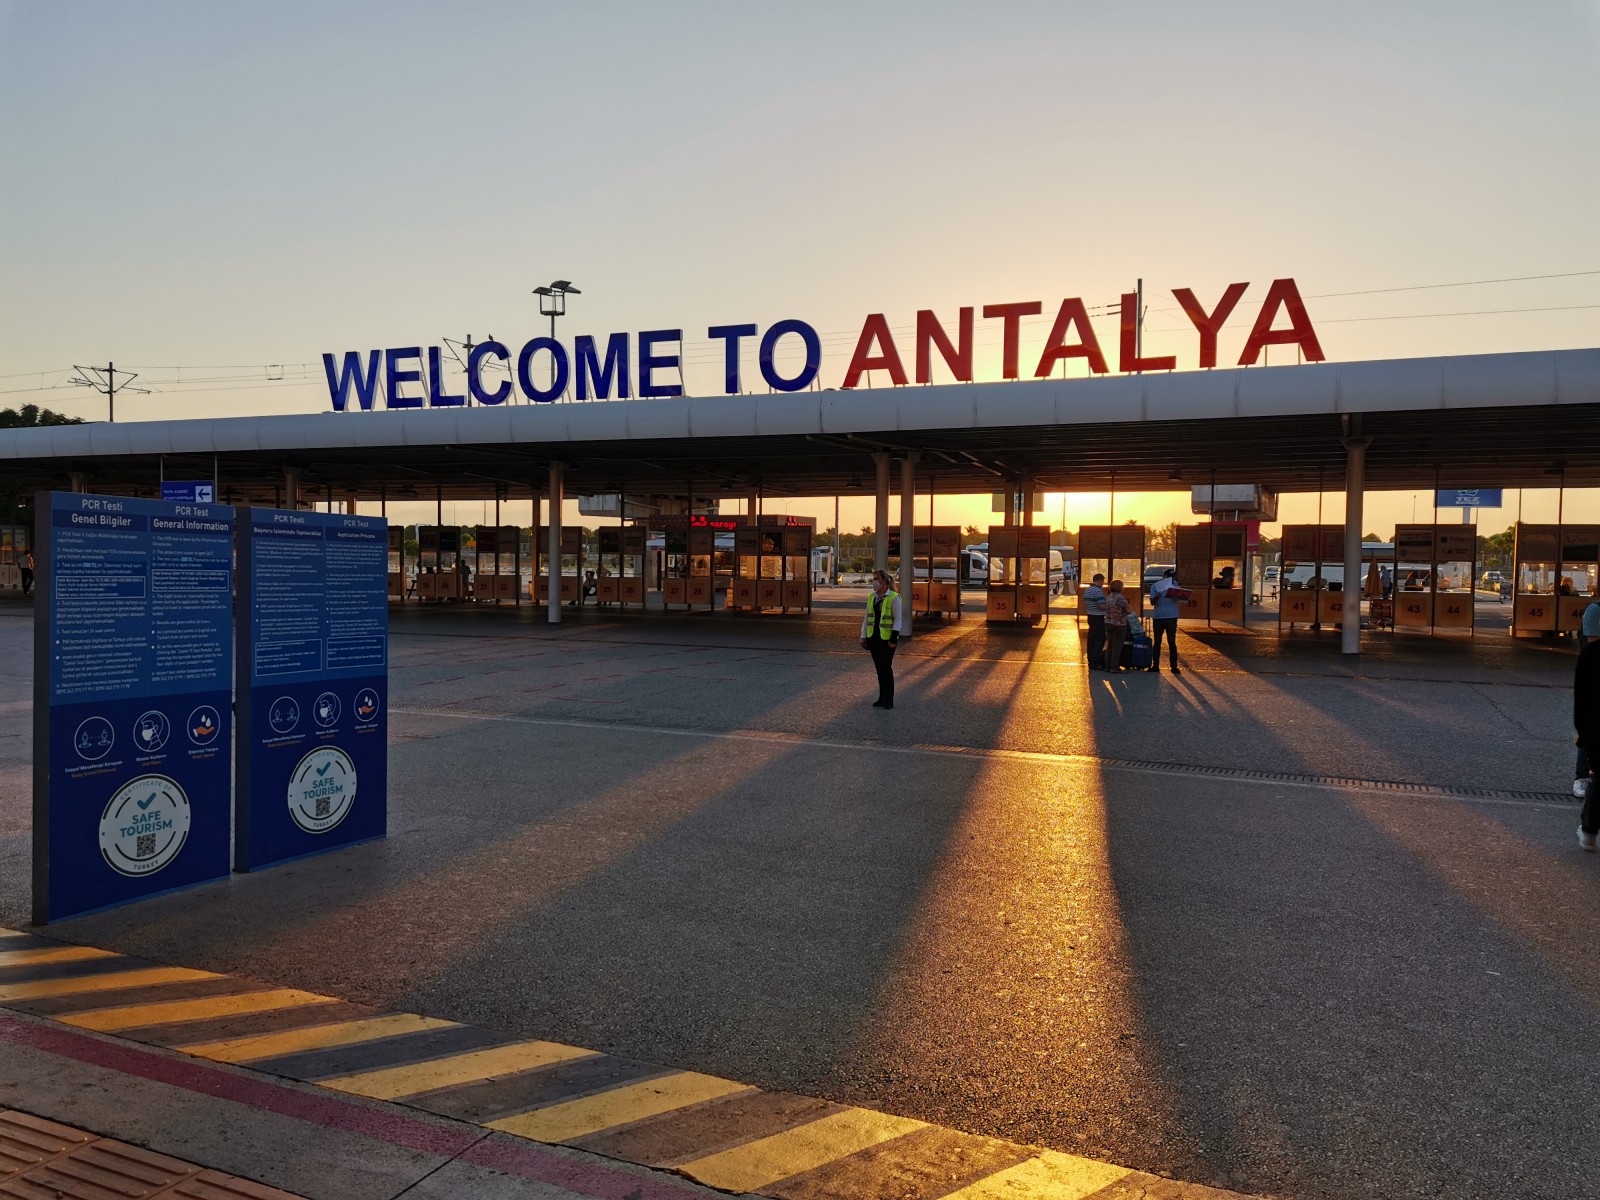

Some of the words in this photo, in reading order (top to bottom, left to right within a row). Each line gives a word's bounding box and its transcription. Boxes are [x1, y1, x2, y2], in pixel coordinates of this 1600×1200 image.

[322, 328, 684, 412] WELCOME
[708, 319, 822, 395] TO
[842, 278, 1326, 388] ANTALYA
[82, 499, 101, 510] PCR
[102, 500, 123, 511] Testi
[175, 506, 192, 515] PCR
[193, 507, 209, 517] Test
[72, 513, 98, 524] Genel
[100, 515, 132, 527] Bilgiler
[289, 516, 305, 524] Testi
[343, 519, 356, 527] PCR
[357, 520, 369, 528] Test
[153, 519, 184, 529] General
[186, 520, 229, 531] Information
[625, 586, 634, 594] 26
[740, 588, 749, 596] 29
[765, 589, 774, 597] 30
[790, 590, 798, 598] 31
[1026, 595, 1036, 603] 36
[996, 602, 1006, 610] 35
[1186, 600, 1197, 608] 39
[1220, 600, 1232, 608] 40
[1293, 602, 1304, 611] 41
[1330, 603, 1343, 611] 42
[1407, 604, 1420, 613] 43
[1447, 605, 1460, 614] 44
[1529, 608, 1544, 617] 45
[304, 752, 336, 767] CERTIFICATE
[312, 777, 334, 789] SAFE
[120, 780, 162, 800] CERTIFICATE
[303, 785, 343, 800] TOURISM
[132, 810, 161, 825] SAFE
[313, 819, 333, 827] TURKEY
[120, 819, 172, 838] TOURISM
[133, 860, 159, 870] TURKEY
